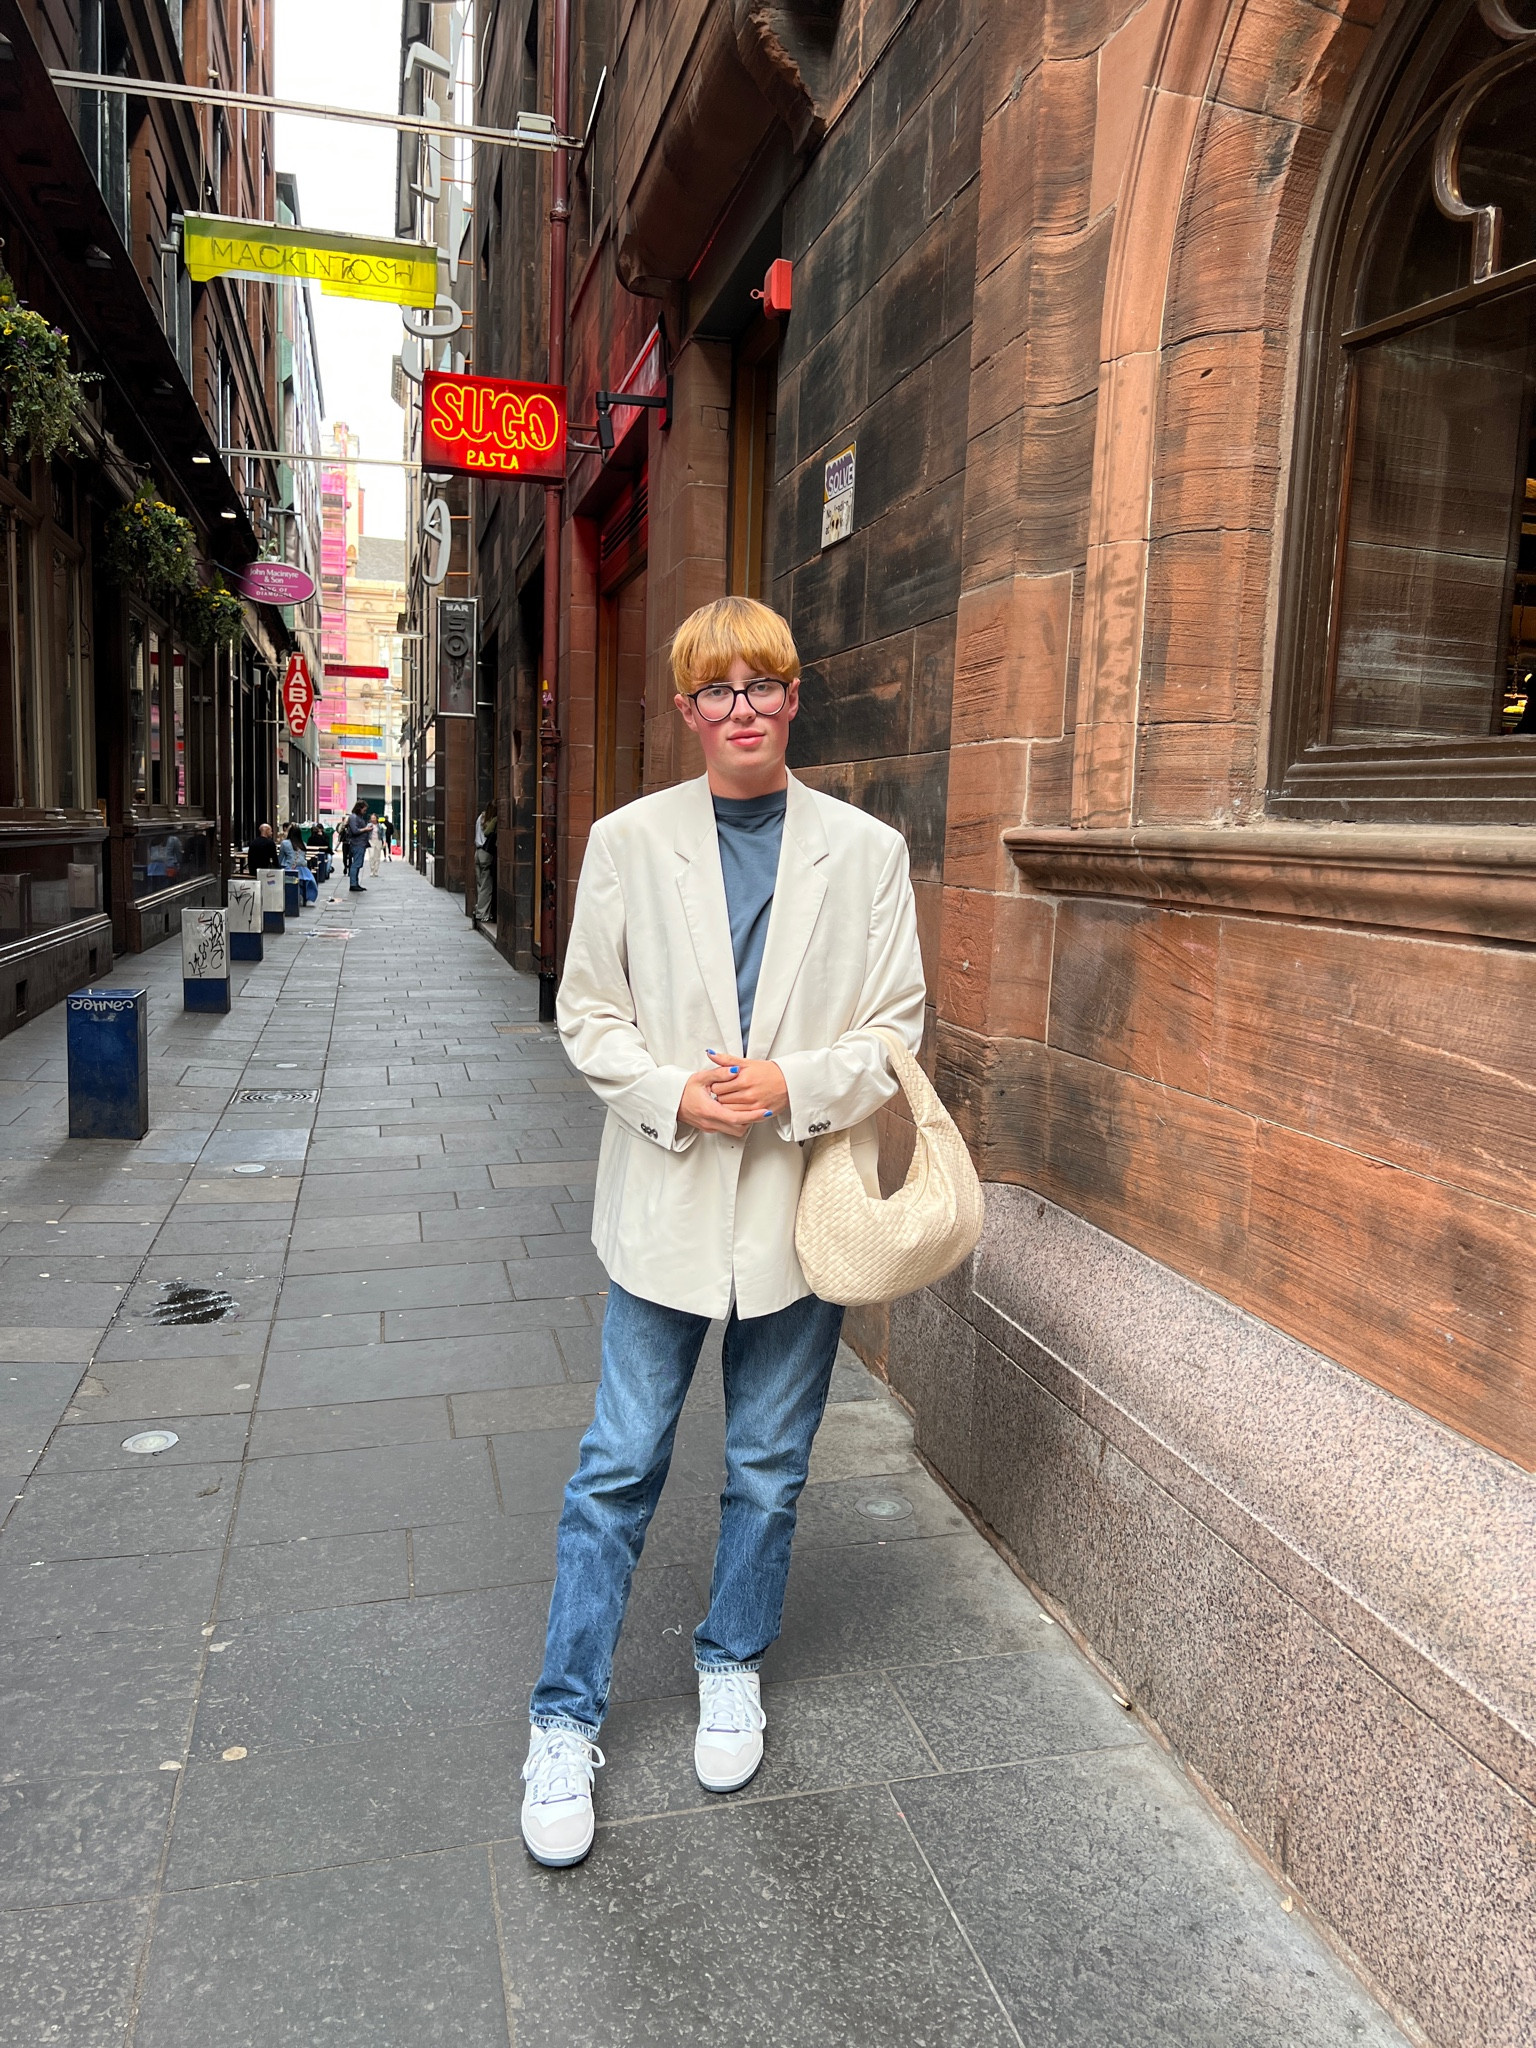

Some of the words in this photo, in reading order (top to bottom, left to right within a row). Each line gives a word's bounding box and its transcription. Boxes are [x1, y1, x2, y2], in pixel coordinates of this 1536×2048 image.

[211, 236, 415, 286] MACKINTOSH
[430, 382, 559, 452] SUGO
[466, 449, 520, 471] PASTA
[828, 464, 854, 496] SOLVE
[250, 568, 266, 576] John
[271, 576, 284, 584] Son
[446, 603, 469, 613] BAR
[289, 655, 308, 734] TABAC
